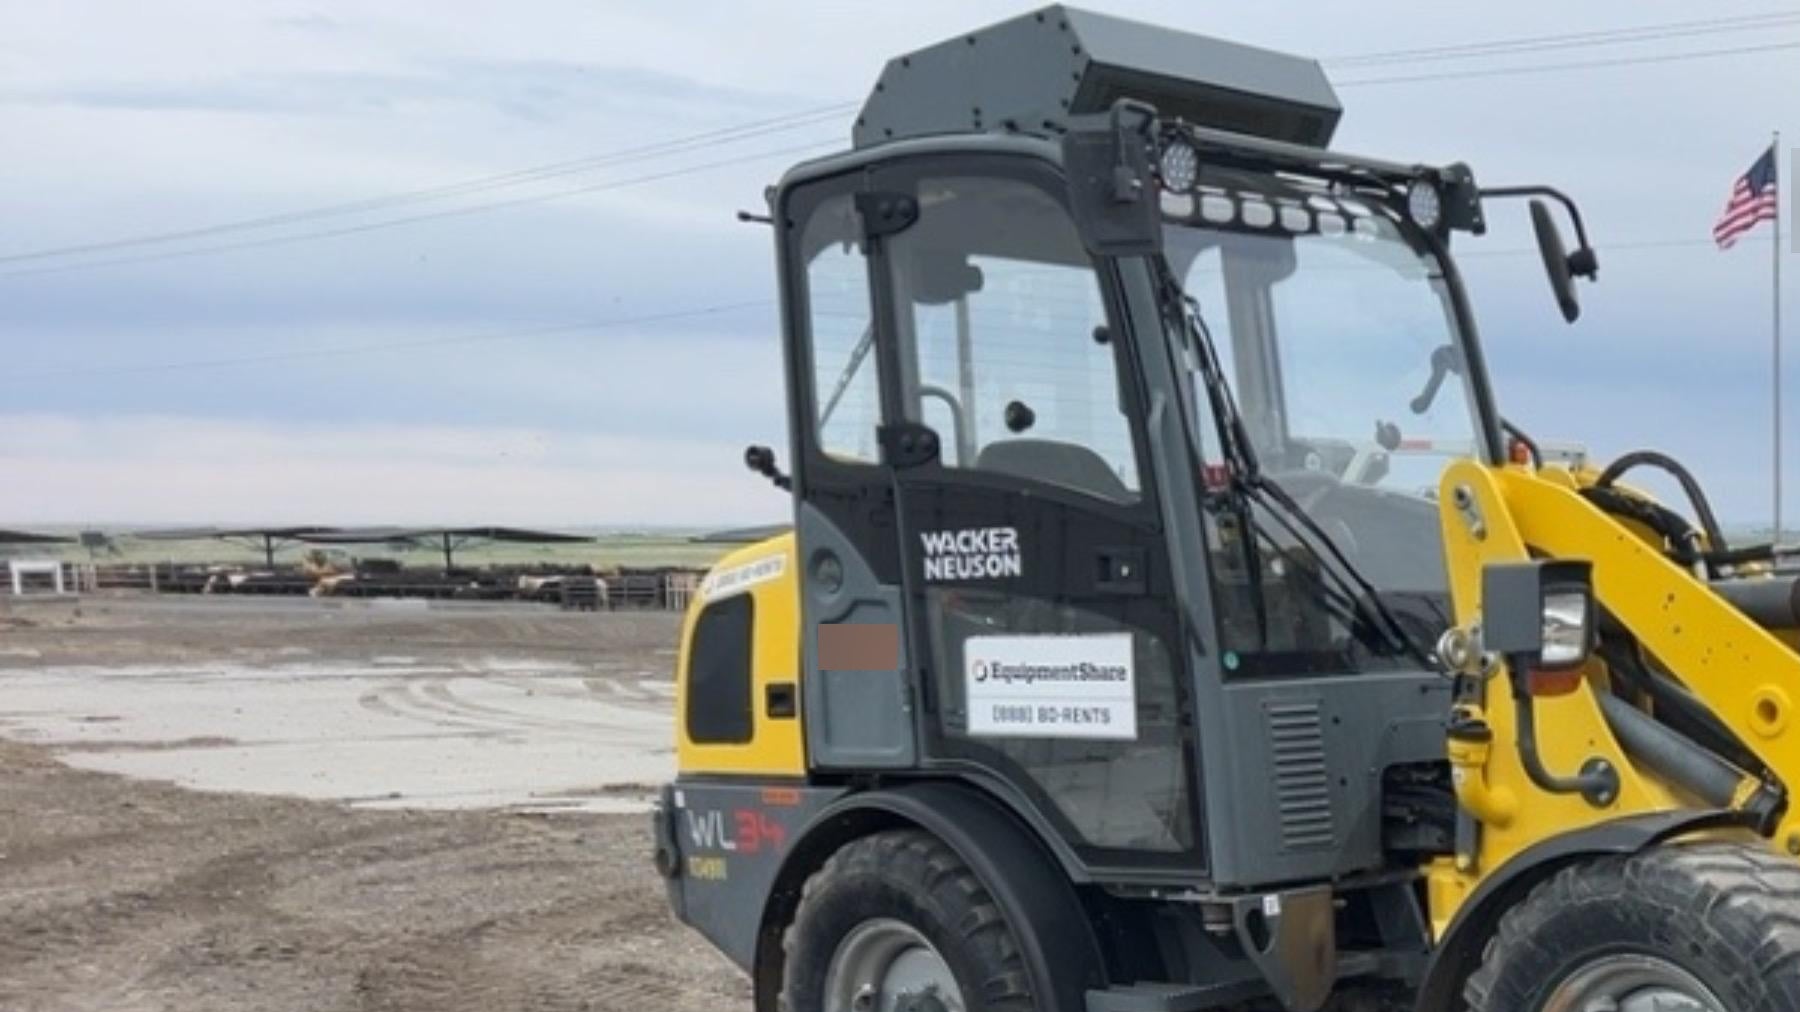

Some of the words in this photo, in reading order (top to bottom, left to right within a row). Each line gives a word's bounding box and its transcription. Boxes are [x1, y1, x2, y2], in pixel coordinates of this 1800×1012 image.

[920, 526, 1019, 555] WACKER
[923, 553, 1022, 580] NEUSON
[991, 661, 1127, 685] EquipmentShare
